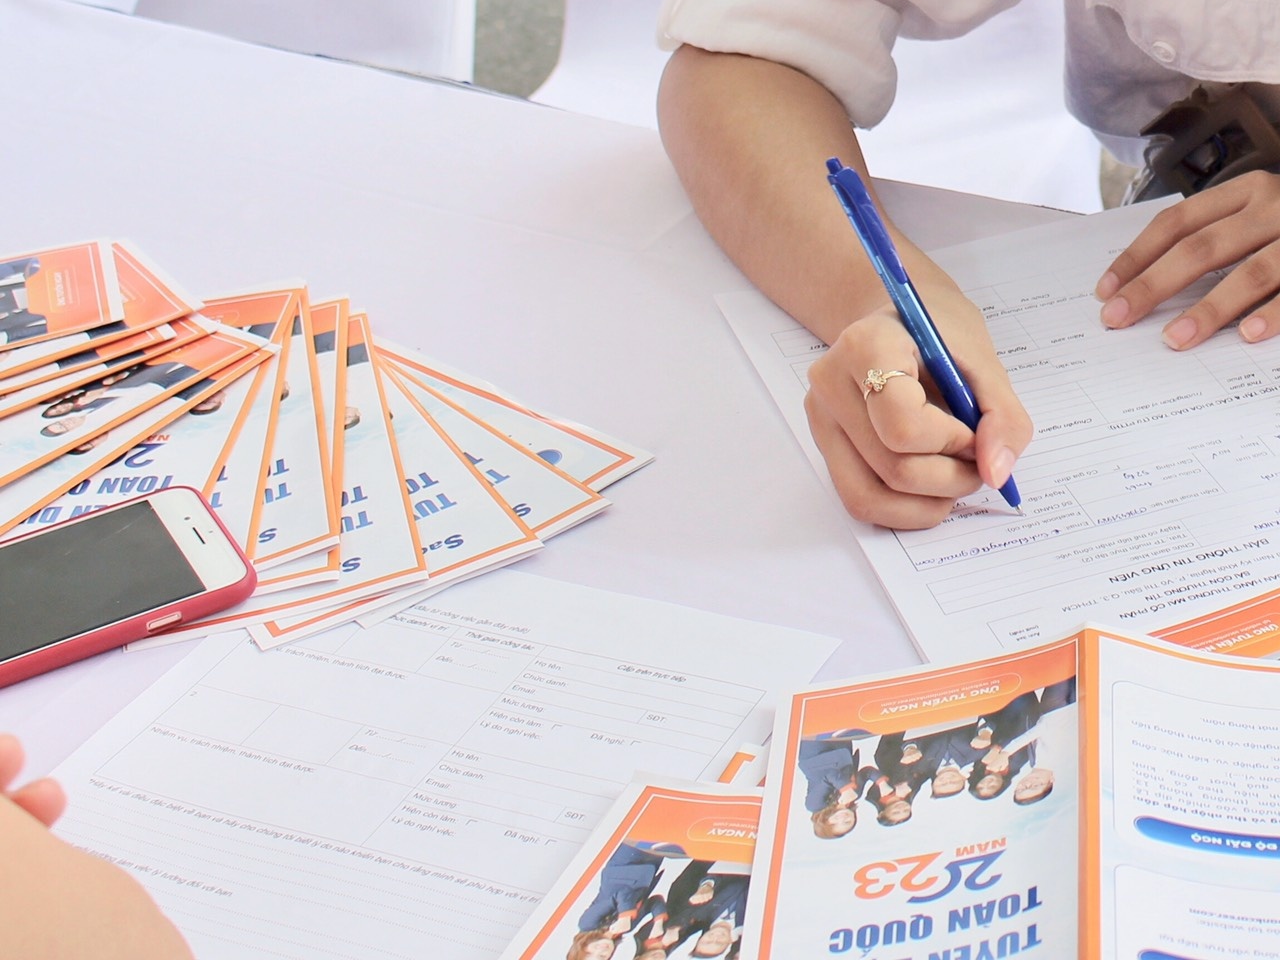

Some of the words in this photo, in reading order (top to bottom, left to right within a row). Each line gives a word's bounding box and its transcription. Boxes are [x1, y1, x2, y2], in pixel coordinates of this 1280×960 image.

[955, 837, 1007, 858] NĂM
[946, 886, 1042, 932] TOÀN
[829, 914, 934, 960] QUỐC
